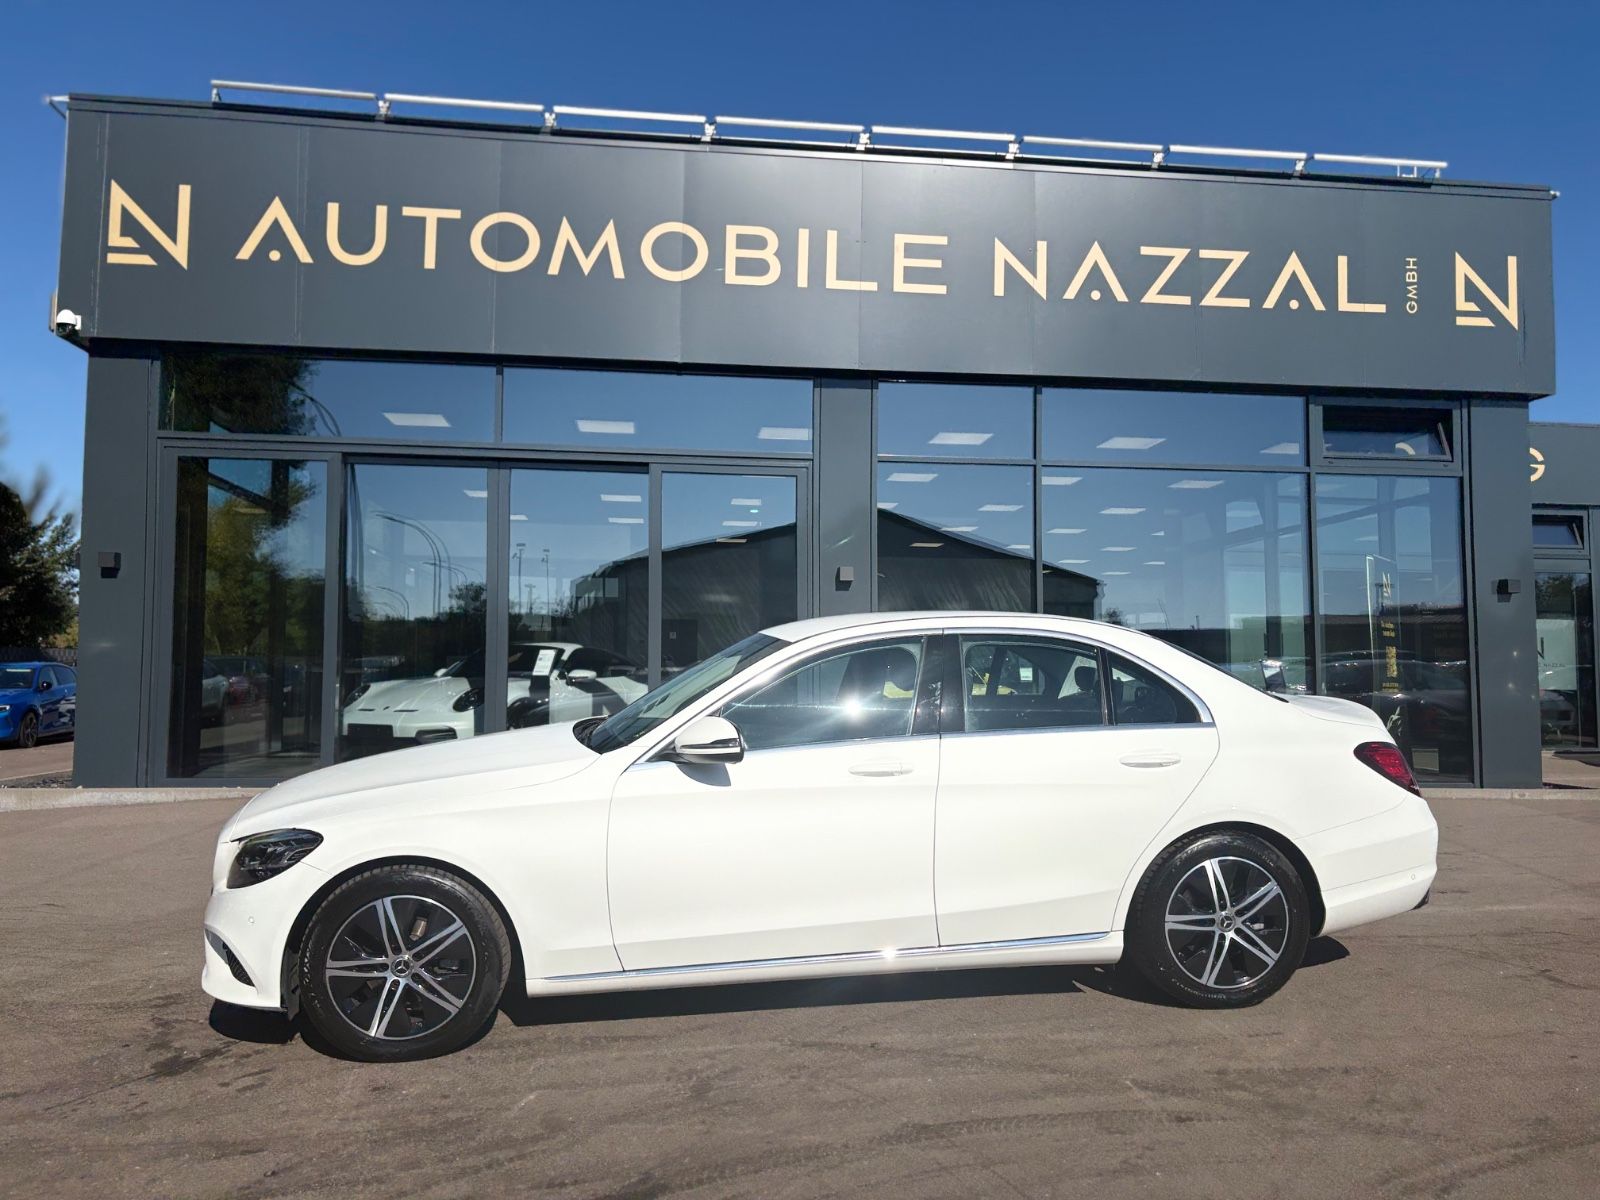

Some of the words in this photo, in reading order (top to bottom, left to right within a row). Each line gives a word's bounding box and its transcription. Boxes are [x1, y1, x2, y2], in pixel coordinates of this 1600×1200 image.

[235, 196, 949, 295] AUTOMOBILE
[994, 237, 1388, 315] NAZZAL
[1403, 256, 1418, 315] GMBH
